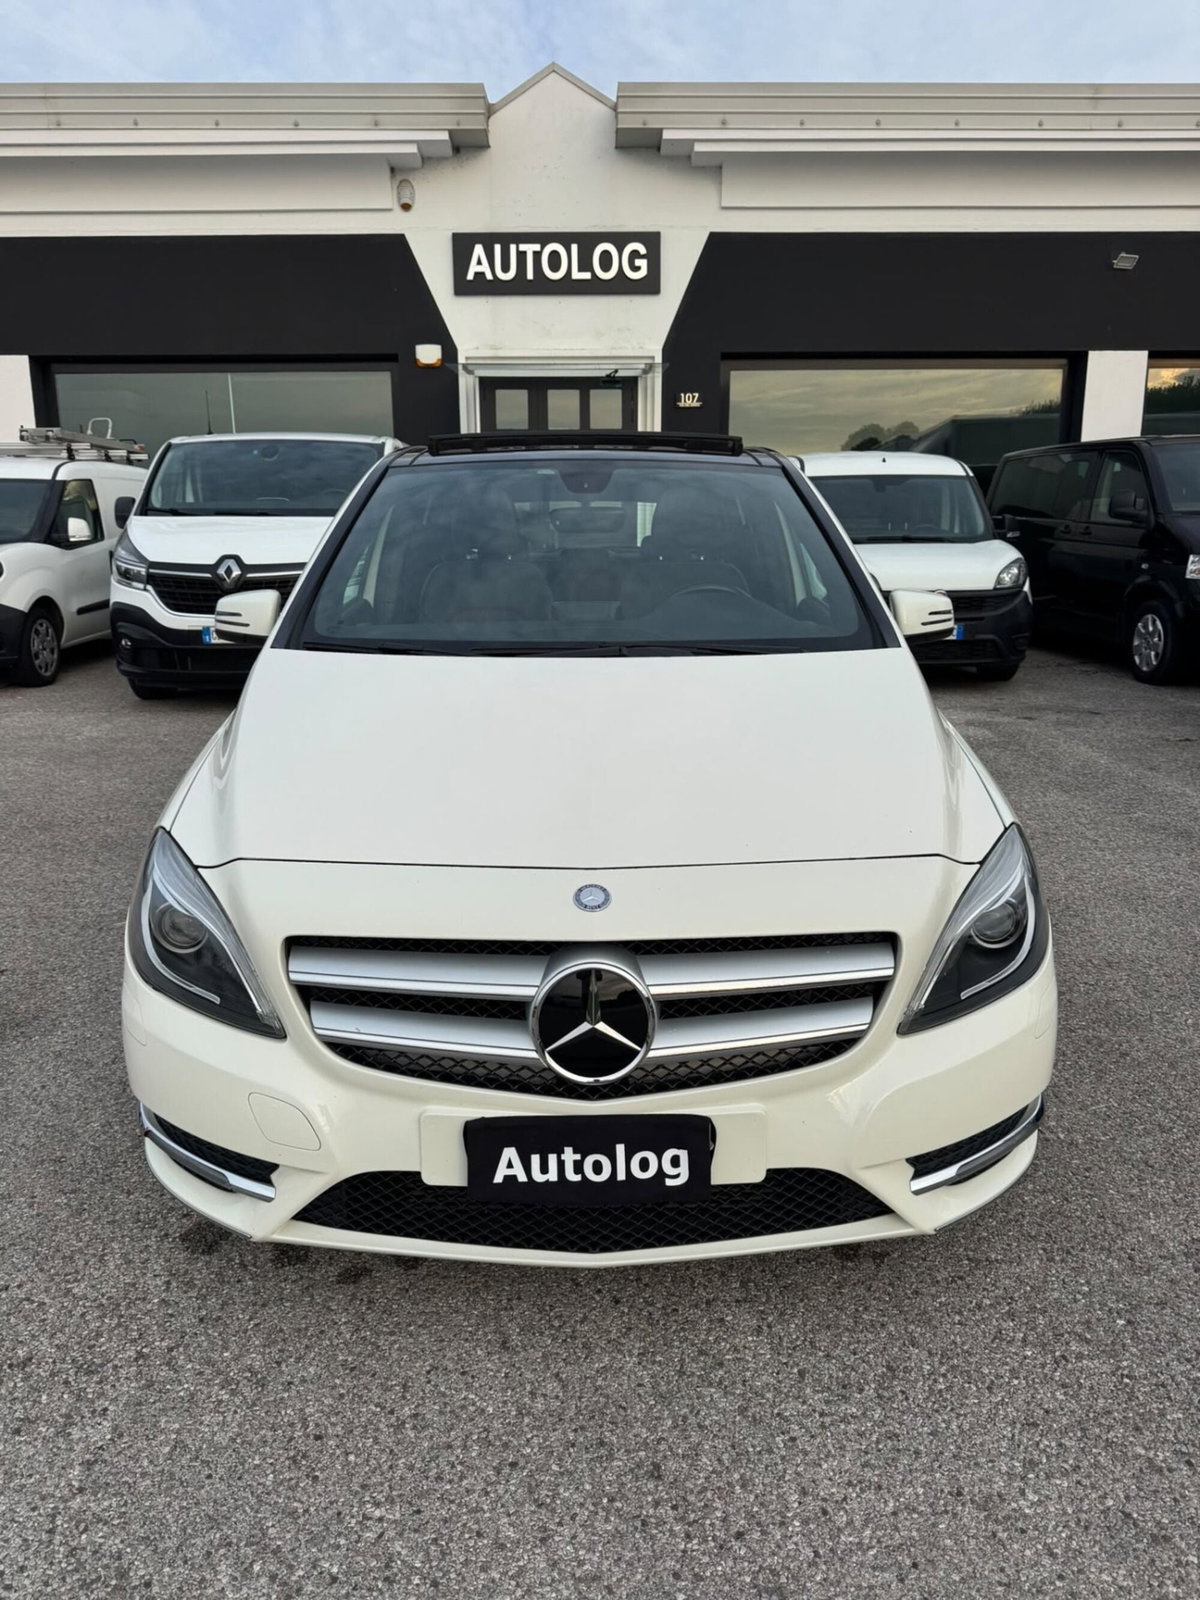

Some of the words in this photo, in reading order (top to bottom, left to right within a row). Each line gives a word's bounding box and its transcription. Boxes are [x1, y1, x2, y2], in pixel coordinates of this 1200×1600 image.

[466, 241, 649, 281] AUTOLOG
[680, 392, 699, 404] 107
[492, 1143, 690, 1187] Autolog
